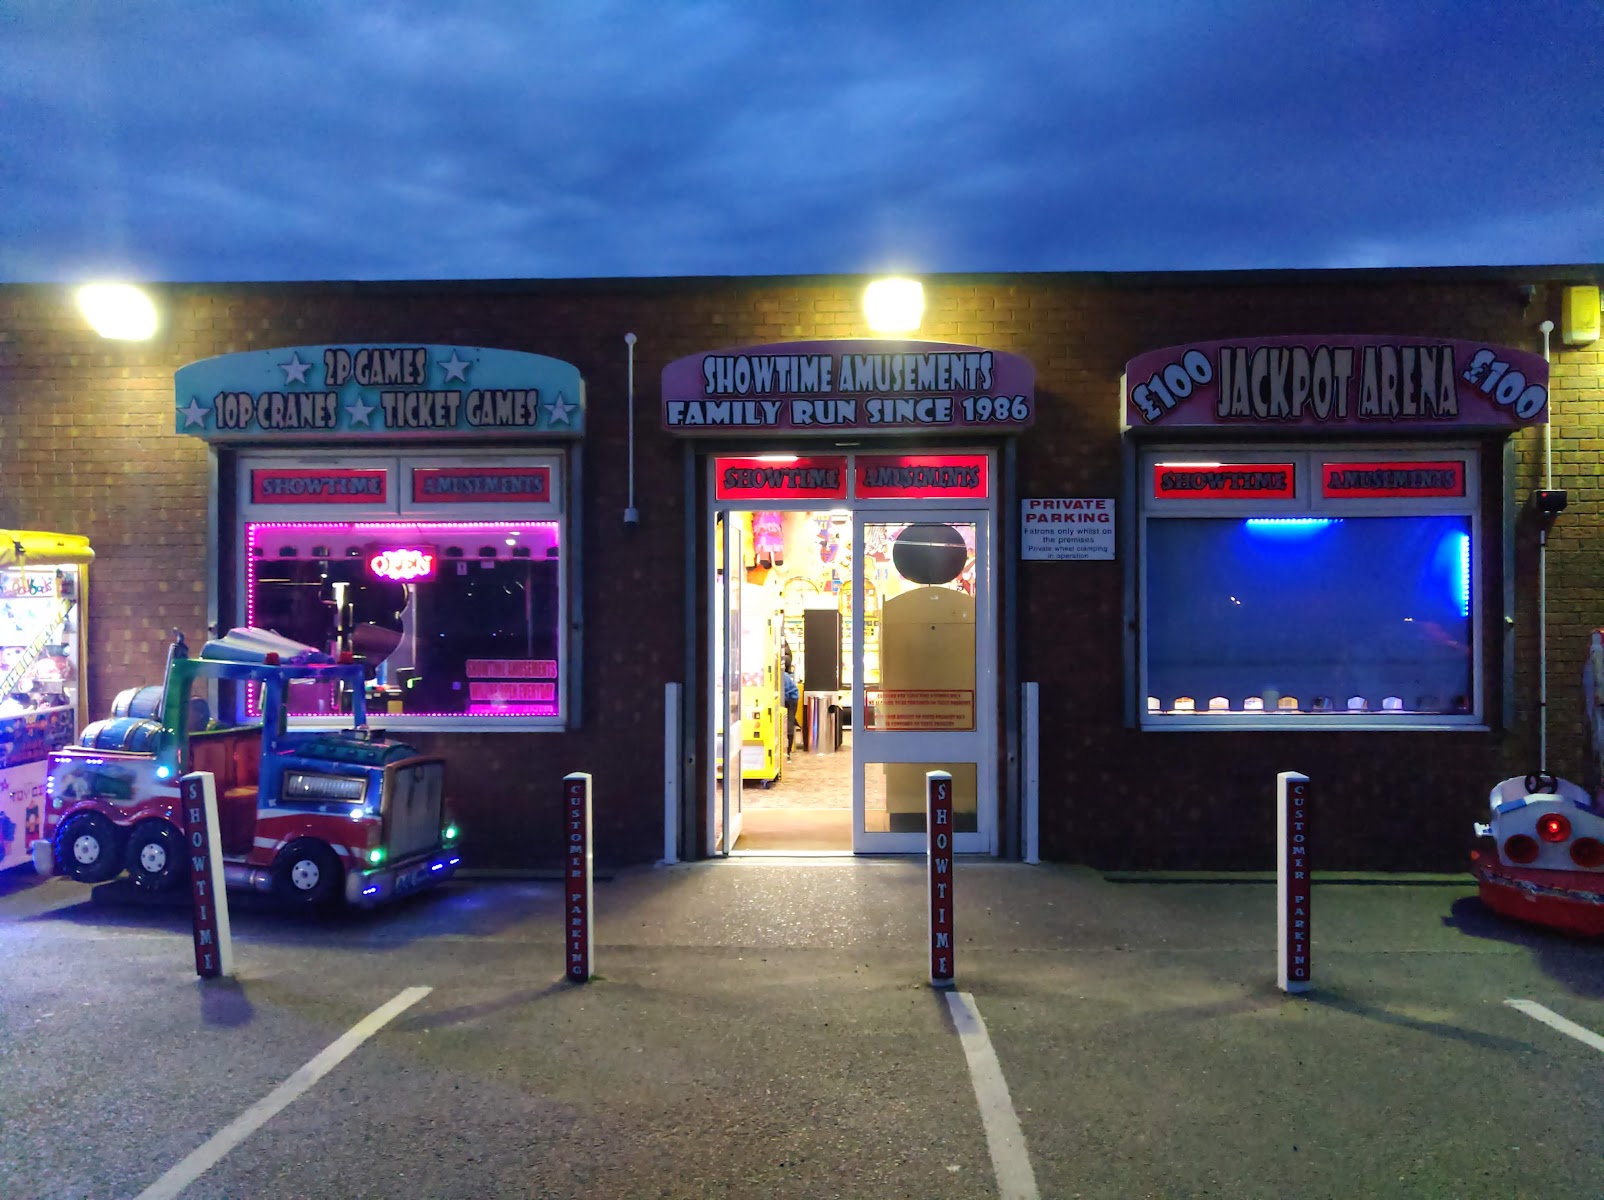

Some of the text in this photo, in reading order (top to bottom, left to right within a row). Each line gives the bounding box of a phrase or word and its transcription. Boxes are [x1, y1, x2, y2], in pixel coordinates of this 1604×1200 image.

[323, 347, 427, 387] 2P GAMES
[703, 352, 994, 394] SHOWTIME AMUSEMENTS
[1131, 348, 1214, 424] £100
[1216, 345, 1460, 419] JACKPOT ARENA
[1462, 347, 1549, 420] £100
[213, 391, 338, 429] 10P CRANES
[380, 389, 539, 429] TICKET GAMES
[666, 395, 1030, 426] FAMILY RUN SINCE 1986
[262, 475, 545, 497] SHOWTIME AMUSEMENTS
[723, 465, 980, 490] SHOWTIME AMUSEMENTS
[1160, 470, 1456, 491] SHOWTIME AMUSEMENTS
[1025, 513, 1111, 523] PARKING
[1030, 500, 1106, 510] PRIVATE
[1057, 528, 1074, 536] only
[1076, 545, 1108, 553] clamping
[371, 549, 432, 580] OPEN
[188, 784, 213, 970] SHOWTIME
[569, 785, 583, 975] CUSTOMER PARKING
[935, 783, 949, 974] SHOWTIME
[1291, 785, 1306, 977] CUSTOMER PARKING
